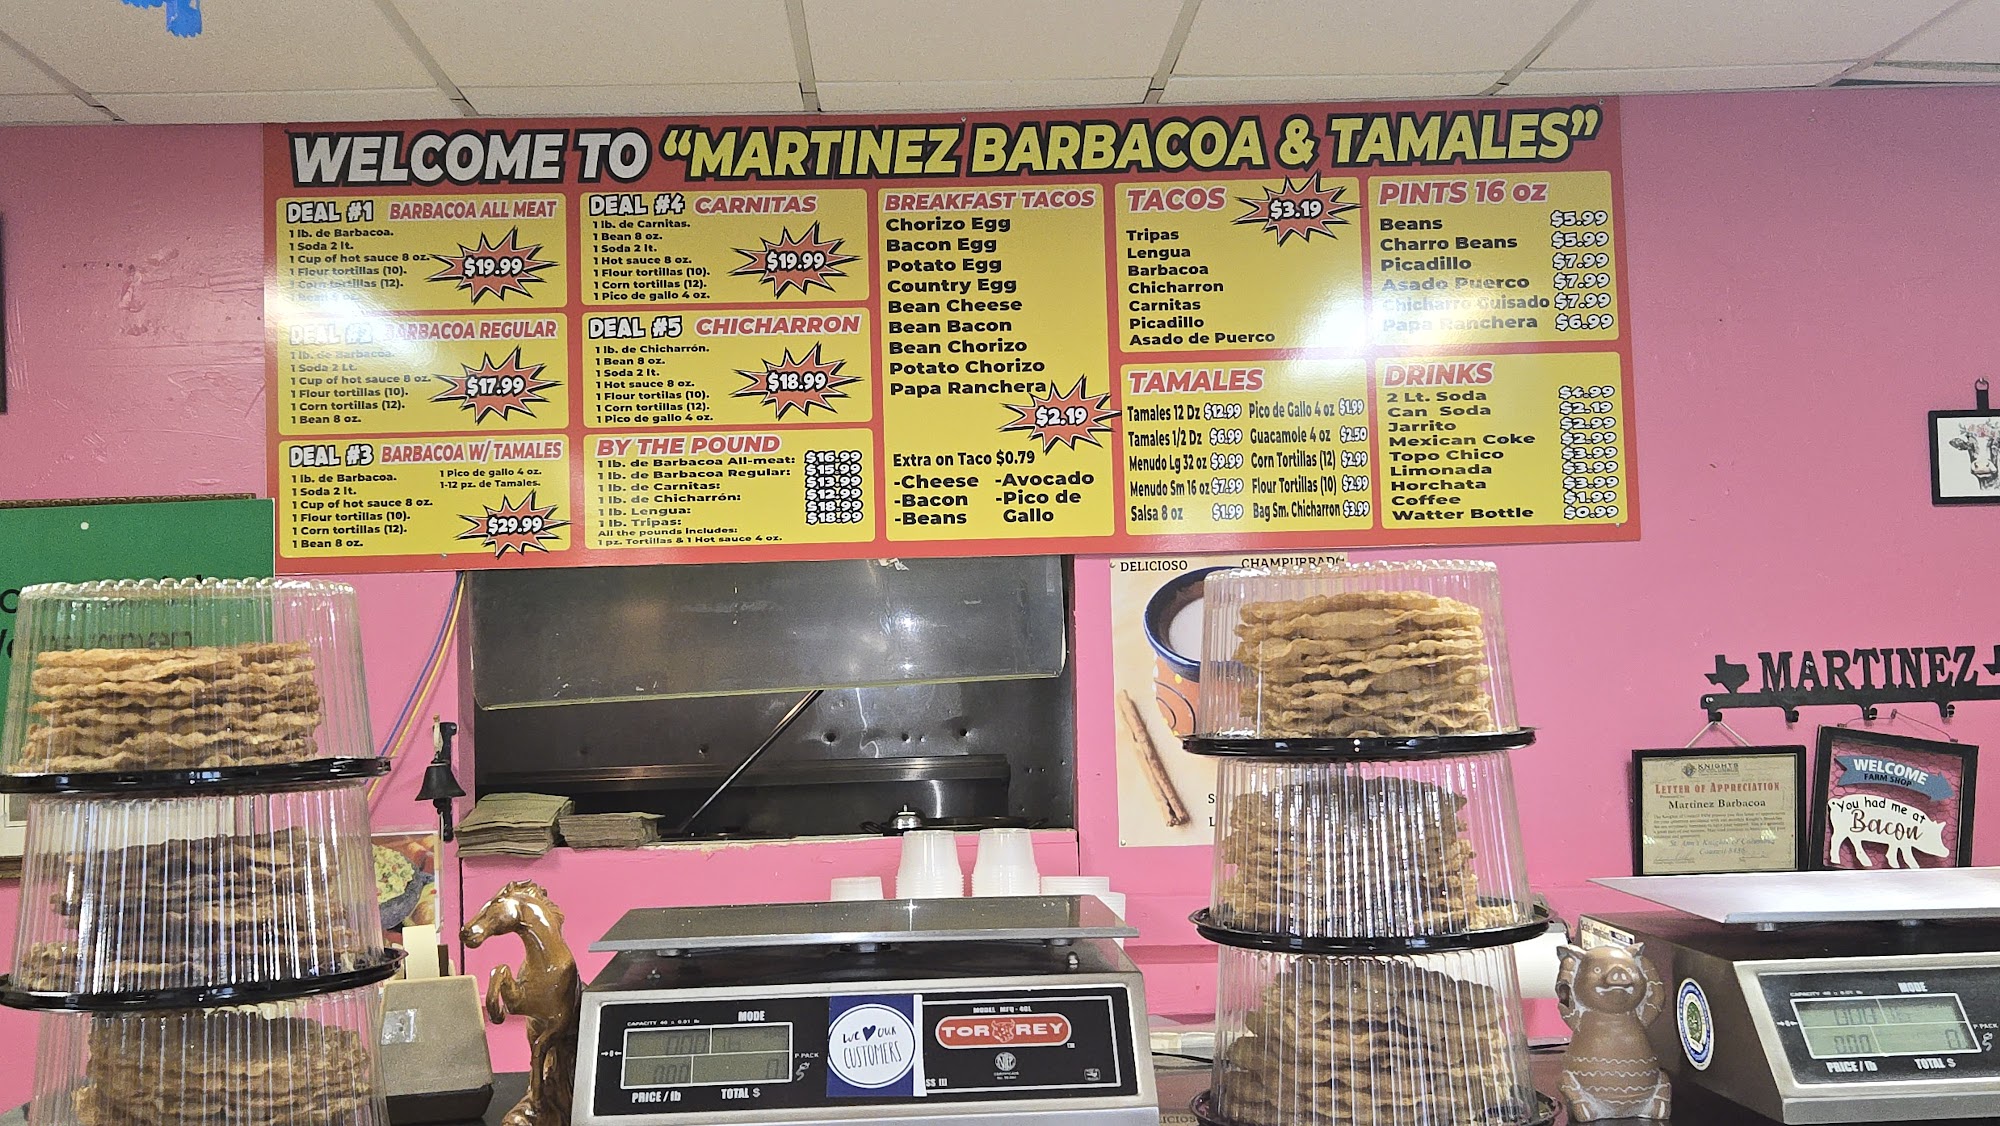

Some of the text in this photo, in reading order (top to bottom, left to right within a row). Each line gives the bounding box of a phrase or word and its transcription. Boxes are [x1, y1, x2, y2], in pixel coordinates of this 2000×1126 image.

[293, 131, 568, 186] WELCOME
[576, 129, 652, 182] TO
[968, 120, 1269, 174] BARBACOA
[1276, 114, 1319, 168] &
[885, 190, 1094, 210] BREAKFAST TACOS
[1127, 188, 1226, 211] TACOS
[1380, 182, 1547, 204] PINTS 16 oz
[286, 201, 374, 222] DEAL #1
[389, 201, 557, 219] BARBACOA ALL MEAT
[589, 193, 685, 216] DEAL #4
[694, 196, 817, 214] CARNITAS
[1270, 200, 1322, 220] $3.19
[593, 219, 690, 229] 1 lb. de Carnitas.
[886, 216, 1011, 232] Chorizo Egg
[1380, 210, 1608, 231] Beans $5.99
[1126, 229, 1179, 243] Tripas
[887, 238, 997, 253] Bacon Egg
[1127, 247, 1190, 260] Lengua
[464, 257, 524, 277] $19.99
[766, 252, 826, 272] $19.99
[888, 258, 1001, 273] Potato Egg
[1128, 264, 1209, 276] Barbacoa
[1381, 253, 1609, 272] Picadillo $7.99
[1129, 281, 1223, 294] Chicharron
[1129, 299, 1201, 311] Carnitas
[480, 321, 557, 339] REGULAR
[589, 316, 682, 338] DEAL #5
[695, 316, 860, 335] CHICHARRON
[1130, 316, 1204, 329] Picadillo
[1130, 331, 1275, 346] Asado de Puerco
[596, 346, 601, 354] 1
[603, 345, 618, 354] lb.
[622, 345, 636, 353] de
[767, 372, 827, 393] $18.99
[1129, 369, 1264, 393] TAMALES
[1385, 363, 1493, 386] DRINKS
[466, 377, 526, 397] $17.99
[1035, 406, 1088, 427] $2.19
[1128, 403, 1242, 421] Tamales 12 Dz $12.99
[1250, 426, 1368, 444] Guacamole 4 oz $2.50
[1389, 431, 1617, 446] Mexican Coke $2.99
[381, 441, 562, 462] BARBACOA W/ TAMALES
[597, 436, 780, 456] BY THE POUND
[289, 444, 374, 467] DEAL #3
[598, 451, 862, 468] 1 lb. de Barbacoa All-meat: $16.99
[893, 450, 1035, 467] Extra on Taco $0.79
[447, 469, 469, 477] Pico
[473, 469, 485, 477] de
[489, 468, 515, 478] gallo
[1391, 461, 1619, 476] Limonada $3.99
[894, 475, 979, 489] -Cheese
[995, 471, 1094, 486] -Avocado
[894, 494, 968, 507] -Bacon
[995, 489, 1081, 505] -Pico de
[1392, 491, 1617, 506] Coffee $1.99
[895, 512, 967, 525] -Beans
[1003, 508, 1054, 523] Gallo
[1392, 505, 1619, 521] Watter Bottle $0.99
[487, 516, 544, 535] $29.99
[1120, 560, 1188, 572] DELICIOSO
[1757, 646, 1978, 691] MARTINEZ
[1853, 758, 1929, 785] WELCOME
[1864, 773, 1912, 787] FARM SHOP
[1669, 799, 1766, 809] Martinez Barbacoa
[1864, 797, 1886, 809] had
[1892, 803, 1908, 815] me
[1912, 812, 1926, 824] at
[1850, 809, 1923, 841] Bacon
[1898, 982, 1928, 993] MODE
[738, 1011, 765, 1022] MODE
[844, 1042, 902, 1069] CUSTOMERS
[1914, 1058, 1956, 1070] TOTAL $
[1825, 1061, 1857, 1073] PRICE
[632, 1092, 662, 1103] PRICE
[721, 1087, 761, 1100] TOTAL $
